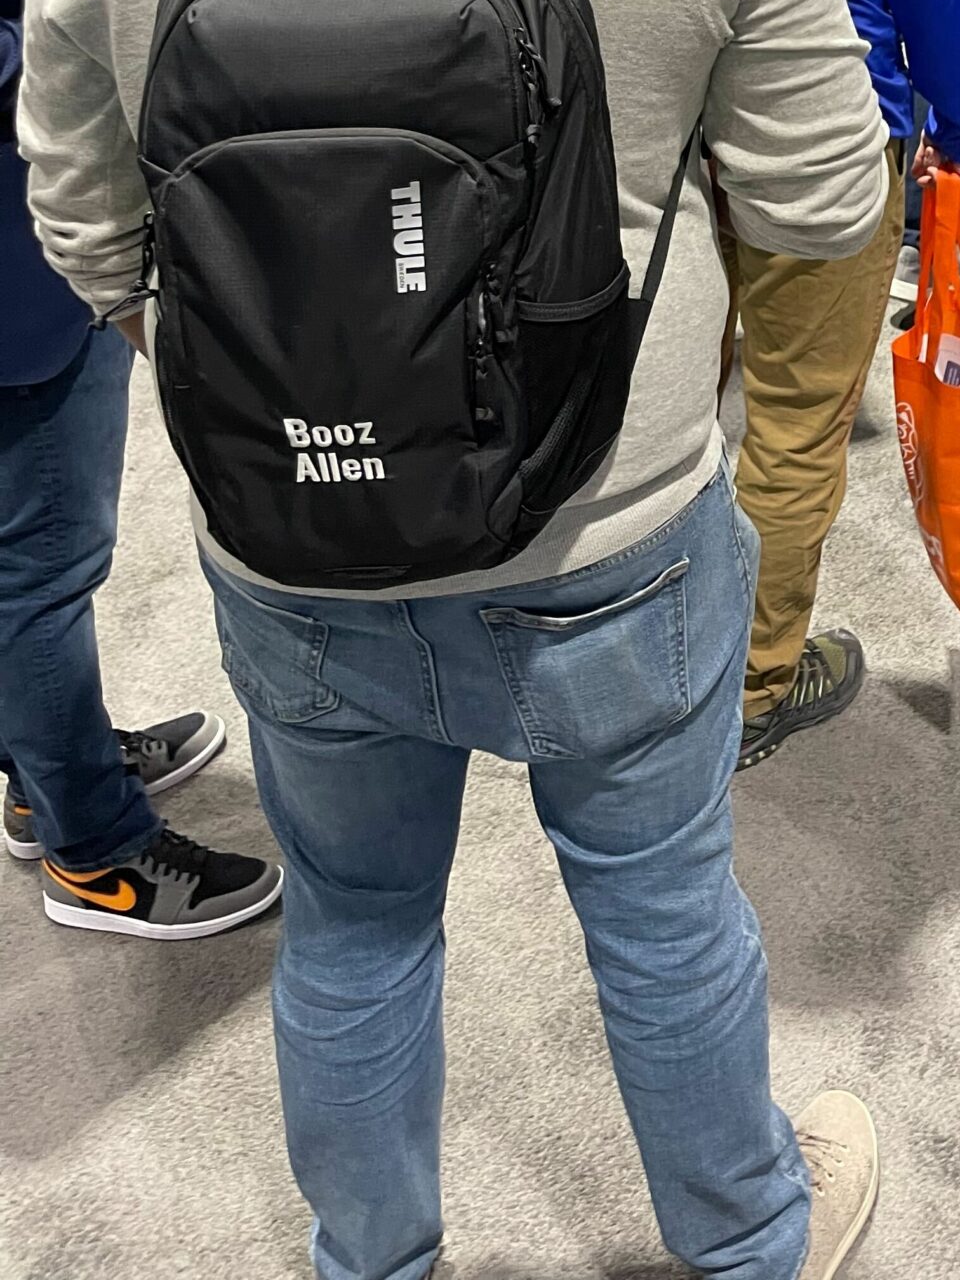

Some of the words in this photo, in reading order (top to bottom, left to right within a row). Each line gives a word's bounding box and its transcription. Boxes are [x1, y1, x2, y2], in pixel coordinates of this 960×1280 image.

[391, 180, 427, 294] THULE
[283, 418, 376, 448] Booz
[295, 452, 385, 483] Allen
